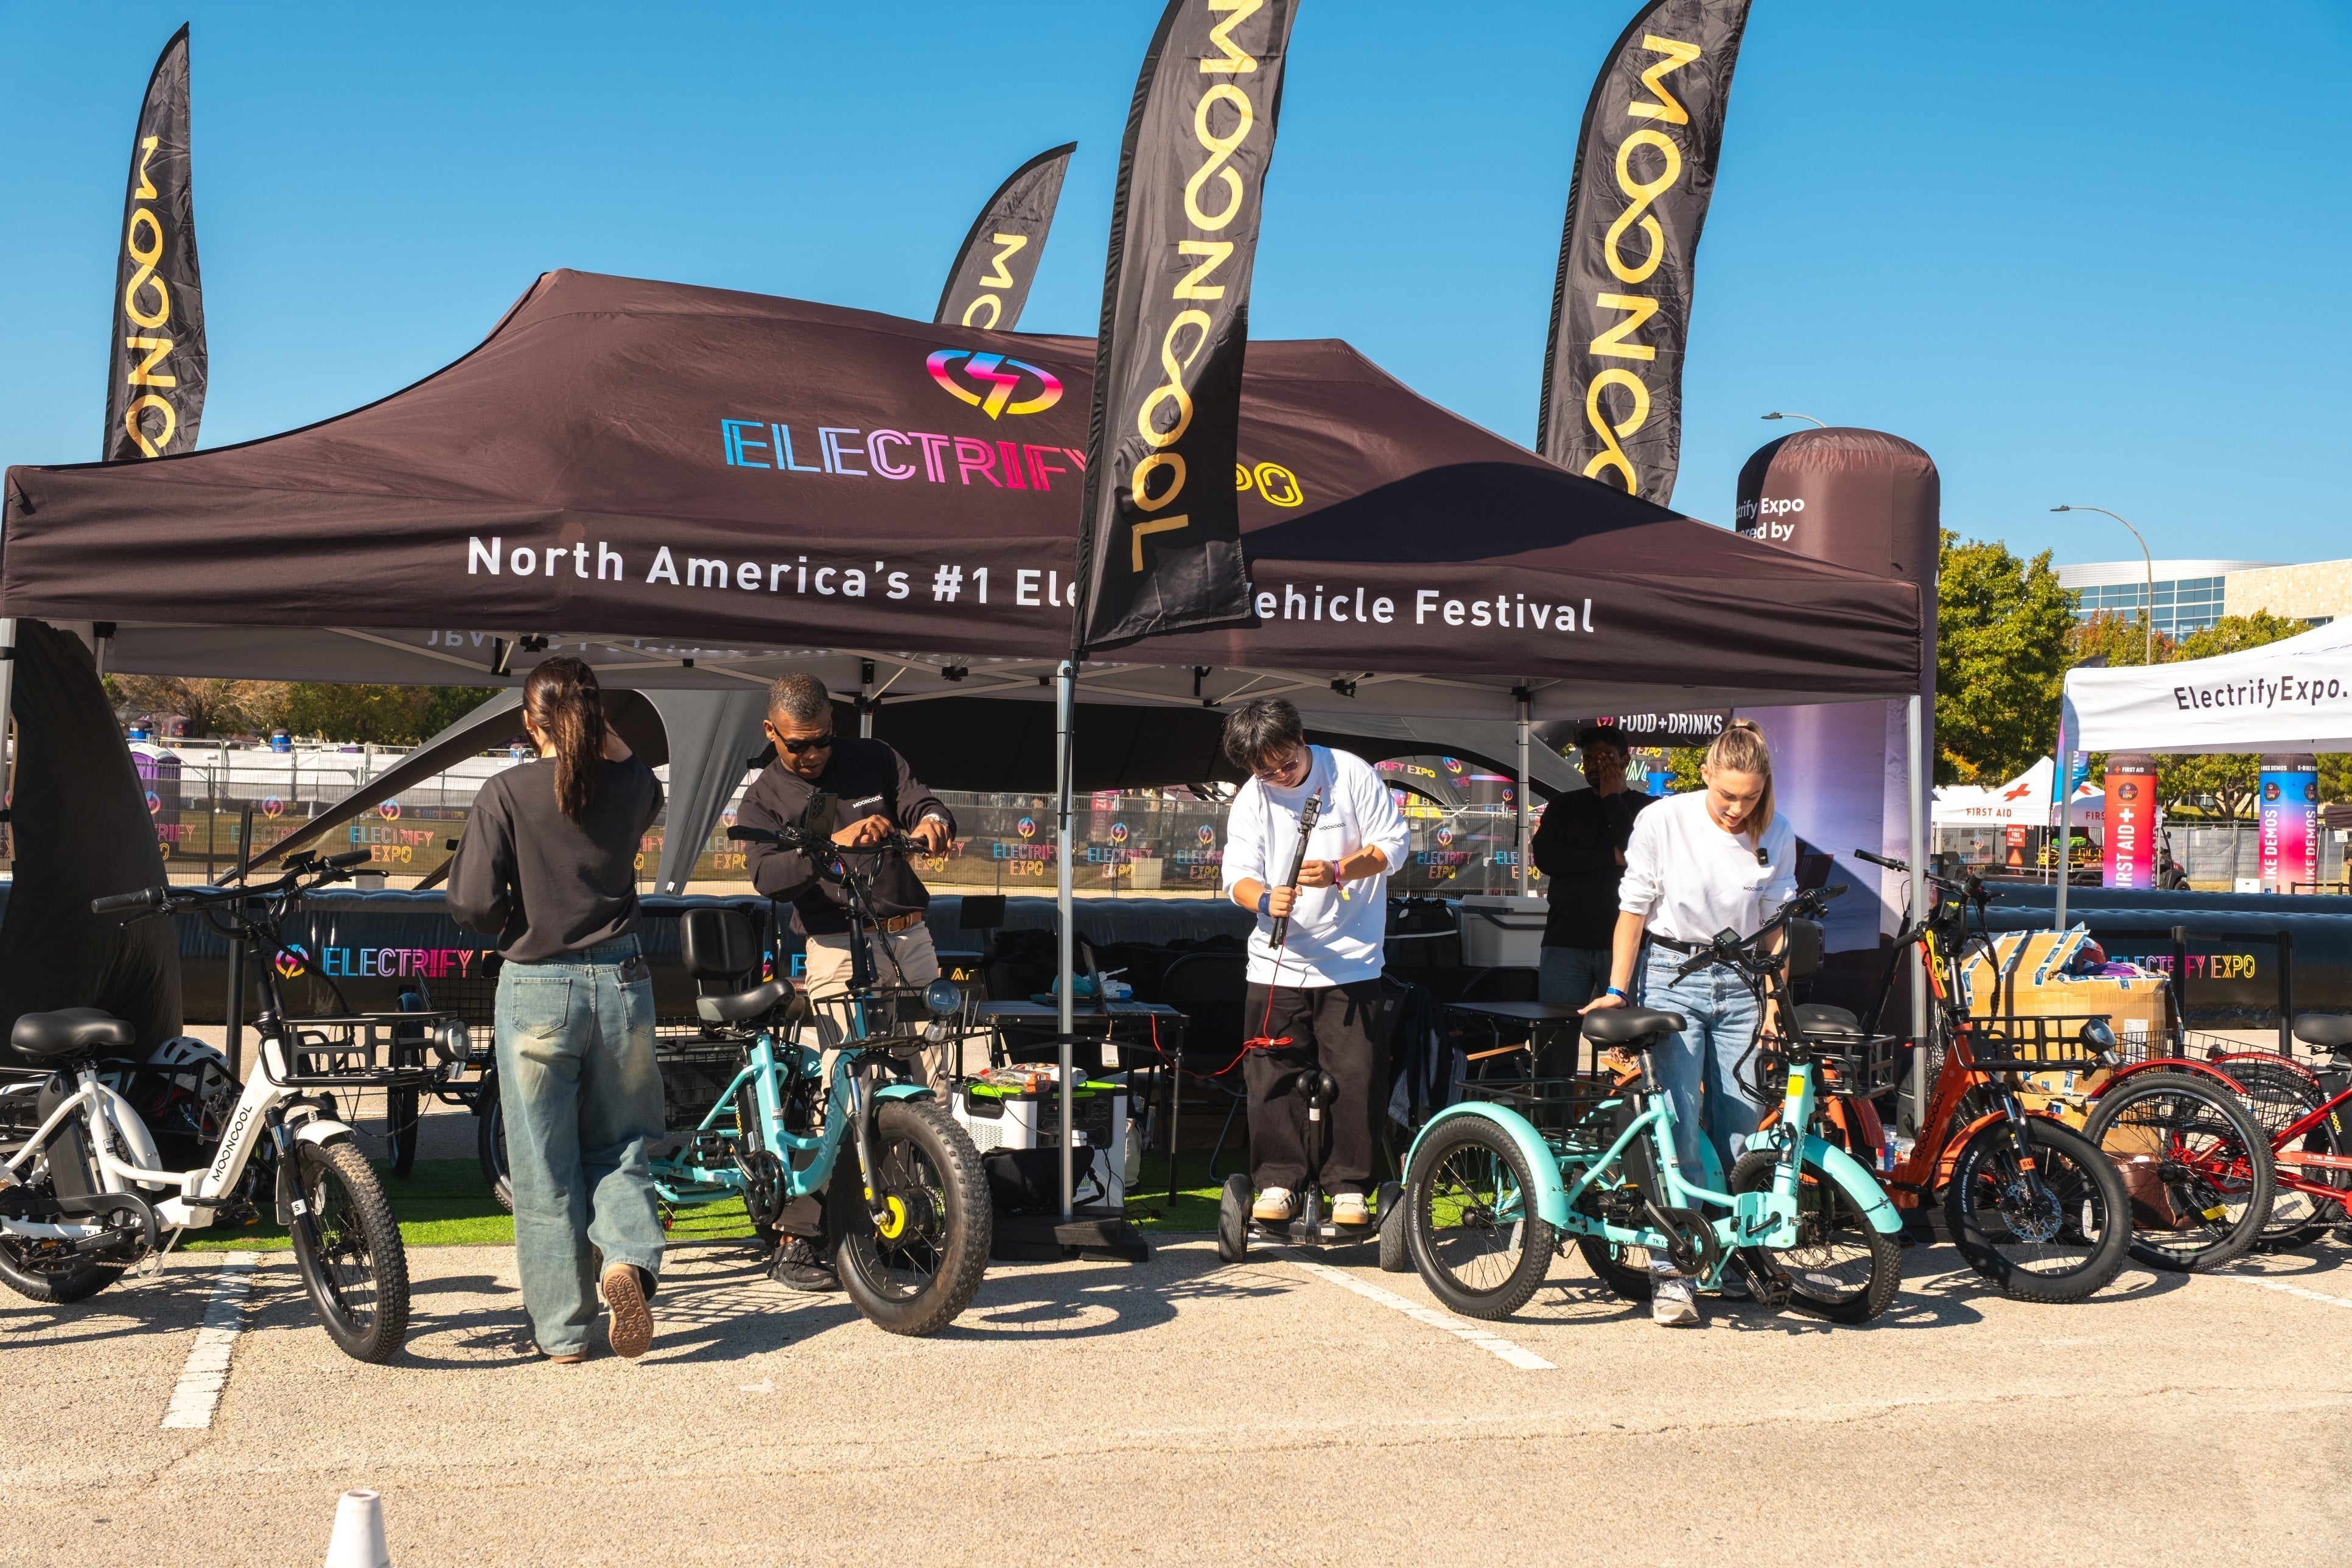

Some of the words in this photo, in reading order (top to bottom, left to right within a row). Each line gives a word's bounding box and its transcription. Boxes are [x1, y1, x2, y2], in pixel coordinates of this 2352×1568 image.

[1583, 34, 1701, 495] MOONC
[1131, 0, 1263, 572] MOONCOOL
[125, 136, 177, 458] MOONC
[1760, 497, 1805, 517] Expo
[1771, 522, 1795, 541] by
[467, 536, 624, 581] North
[932, 564, 989, 604] #1
[1245, 583, 1395, 625] ehicle
[1416, 589, 1594, 634] Festival
[1407, 765, 1436, 778] EXPO
[853, 795, 883, 808] MOONCOOL
[1967, 808, 1992, 817] FIRST
[1996, 808, 2012, 817] AID
[1319, 822, 1346, 831] MOONCOOL
[2264, 810, 2278, 855] DEMOS
[350, 826, 433, 847] ELECTRIFY
[2117, 825, 2135, 851] AID
[371, 845, 412, 863] EXPO
[1088, 848, 1152, 863] ELECTRIFY
[1177, 850, 1223, 865] ELECTRI
[1417, 851, 1472, 866] ELECTRIFY
[1010, 860, 1043, 877] EXPO
[1101, 863, 1135, 878] EXPO
[1189, 864, 1219, 880] EXPO
[1428, 866, 1455, 880] EXPO
[323, 948, 474, 978] ELECTRIFY
[2211, 954, 2255, 979] EXPO
[1915, 1090, 1945, 1161] MOONCOOL
[212, 1105, 253, 1182] MOONCOOL
